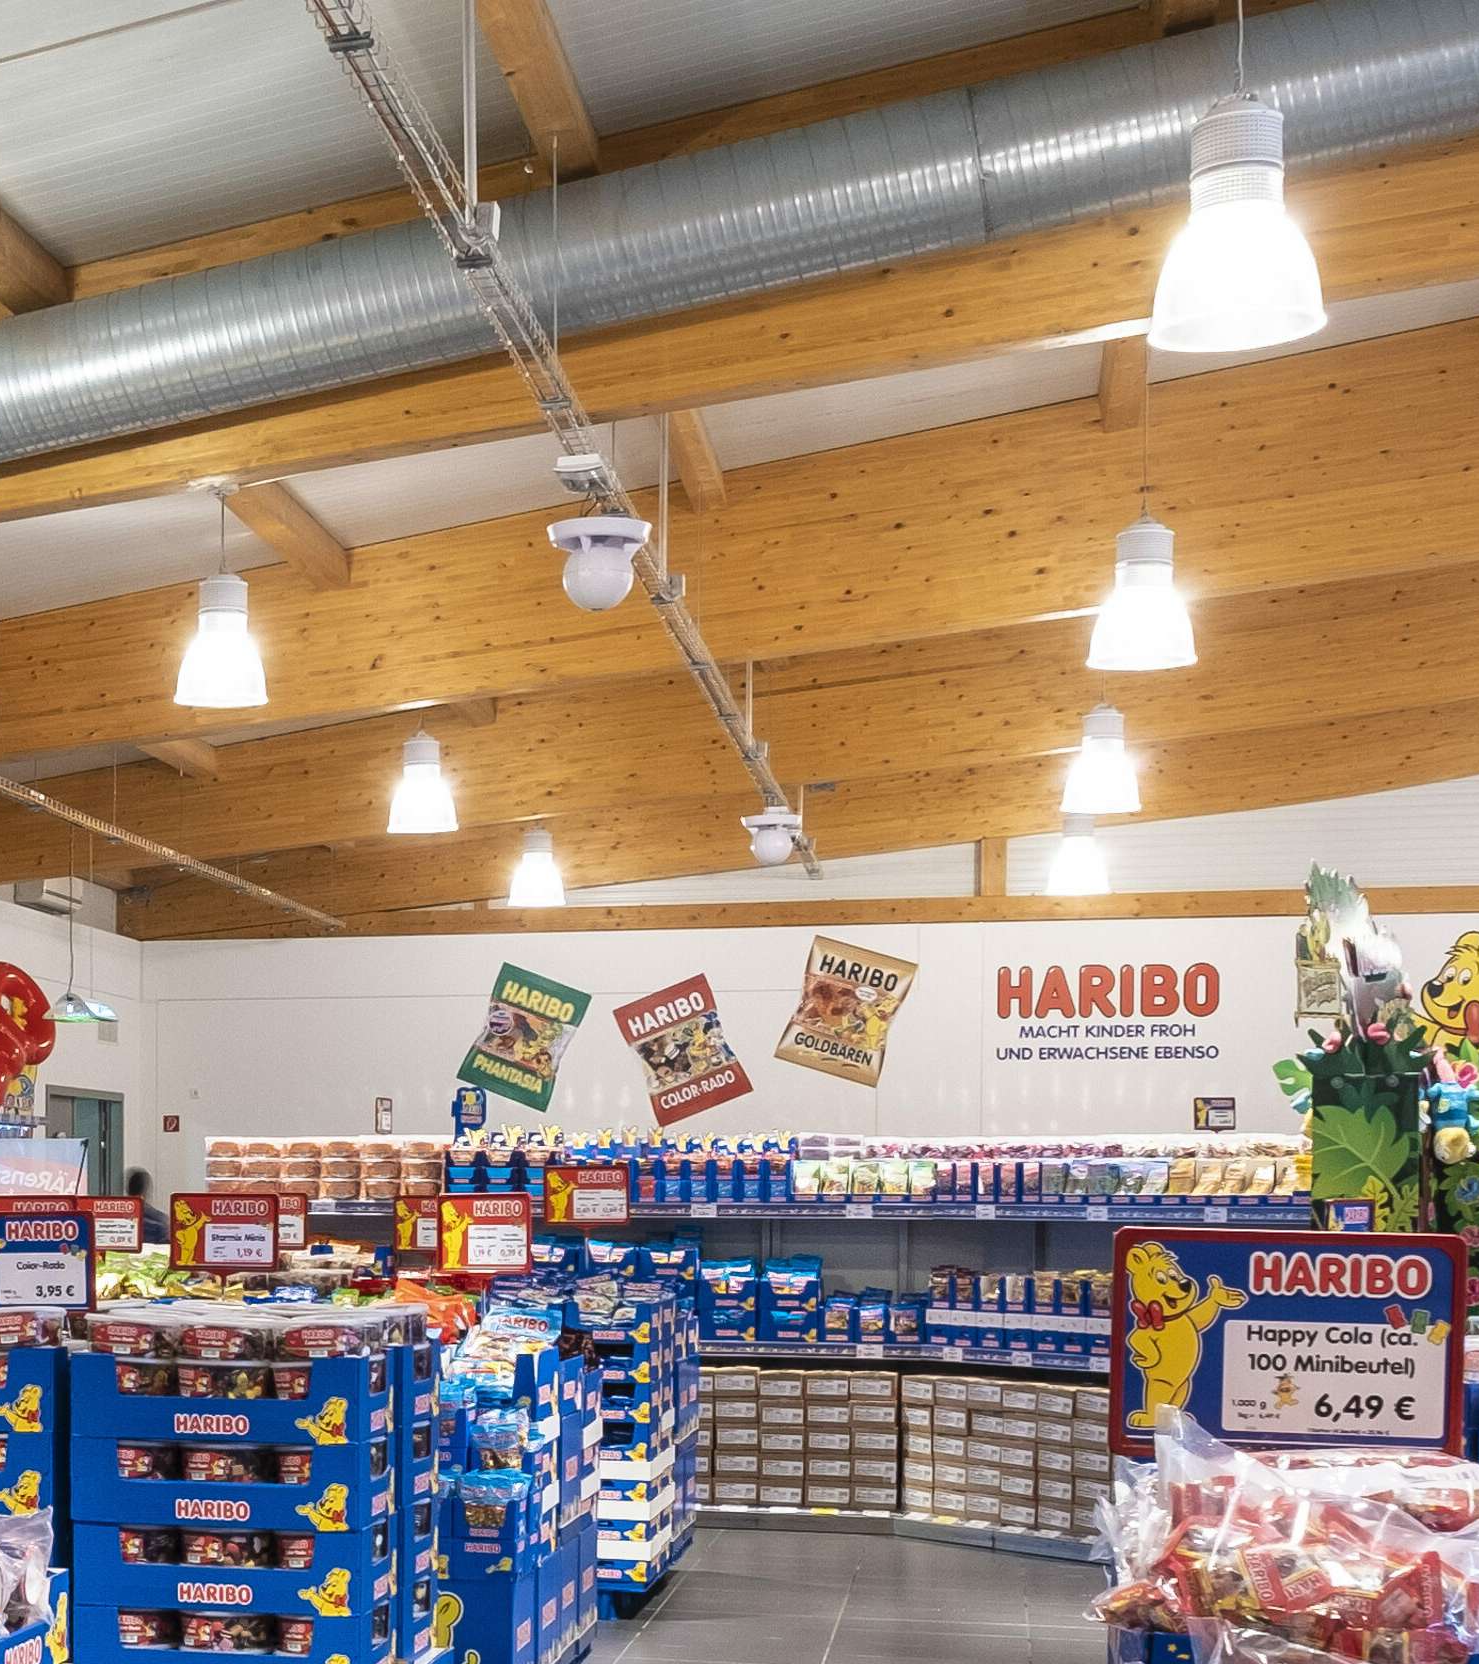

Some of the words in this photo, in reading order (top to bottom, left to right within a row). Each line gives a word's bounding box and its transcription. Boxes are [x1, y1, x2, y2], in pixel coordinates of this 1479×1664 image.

[819, 954, 899, 992] HARIBO
[501, 980, 575, 1021] HARIBO
[997, 962, 1220, 1018] HARIBO
[628, 992, 705, 1037] HARIBO
[1019, 1025, 1079, 1039] MACHT
[1085, 1024, 1145, 1038] KINDER
[1151, 1023, 1195, 1037] FROH
[794, 1032, 873, 1066] GOLDBÄREN
[996, 1047, 1033, 1061] UND
[1039, 1046, 1149, 1060] ERWACHSENE
[1155, 1045, 1219, 1059] EBENSO
[473, 1054, 543, 1094] PHANTASIA
[660, 1070, 735, 1110] COLOR-RADO
[578, 1171, 623, 1184] HARIBO
[93, 1201, 136, 1214] HARIBO
[212, 1199, 269, 1217] HARIBO
[473, 1200, 522, 1216] HARIBO
[6, 1221, 78, 1241] HARIBO
[1250, 1253, 1430, 1297] HARIBO
[35, 1285, 63, 1298] 3,95
[65, 1285, 75, 1297] €
[1247, 1324, 1318, 1348] Happy
[1325, 1326, 1373, 1346] Cola
[1380, 1326, 1419, 1348] (ca.
[1248, 1353, 1287, 1372] 100
[1293, 1354, 1416, 1378] Minibeutel)
[1314, 1393, 1384, 1421] 6,49
[1393, 1396, 1416, 1420] €
[174, 1414, 250, 1435] HARIBO
